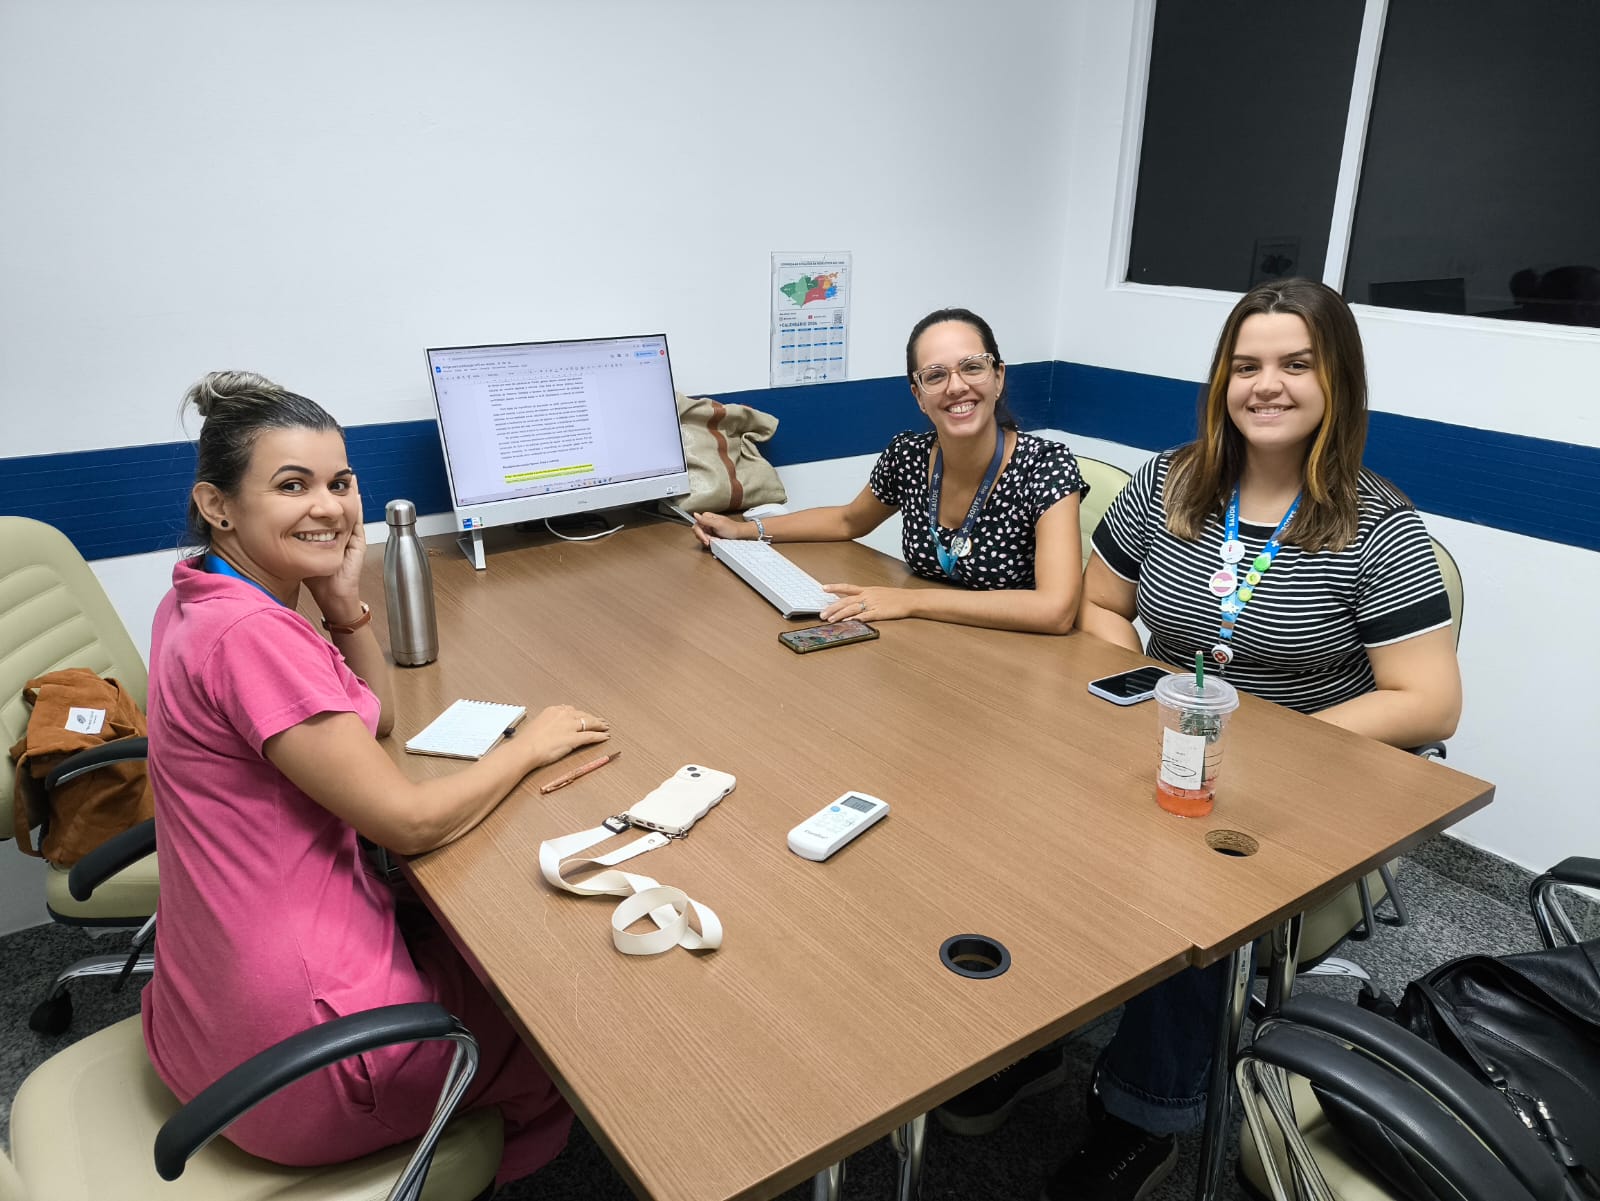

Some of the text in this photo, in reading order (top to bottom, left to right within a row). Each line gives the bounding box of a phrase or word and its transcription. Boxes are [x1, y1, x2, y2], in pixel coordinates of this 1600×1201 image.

[930, 489, 938, 511] SAÚDE
[968, 497, 982, 519] SAÚDE
[1227, 505, 1235, 526] SAÚDE
